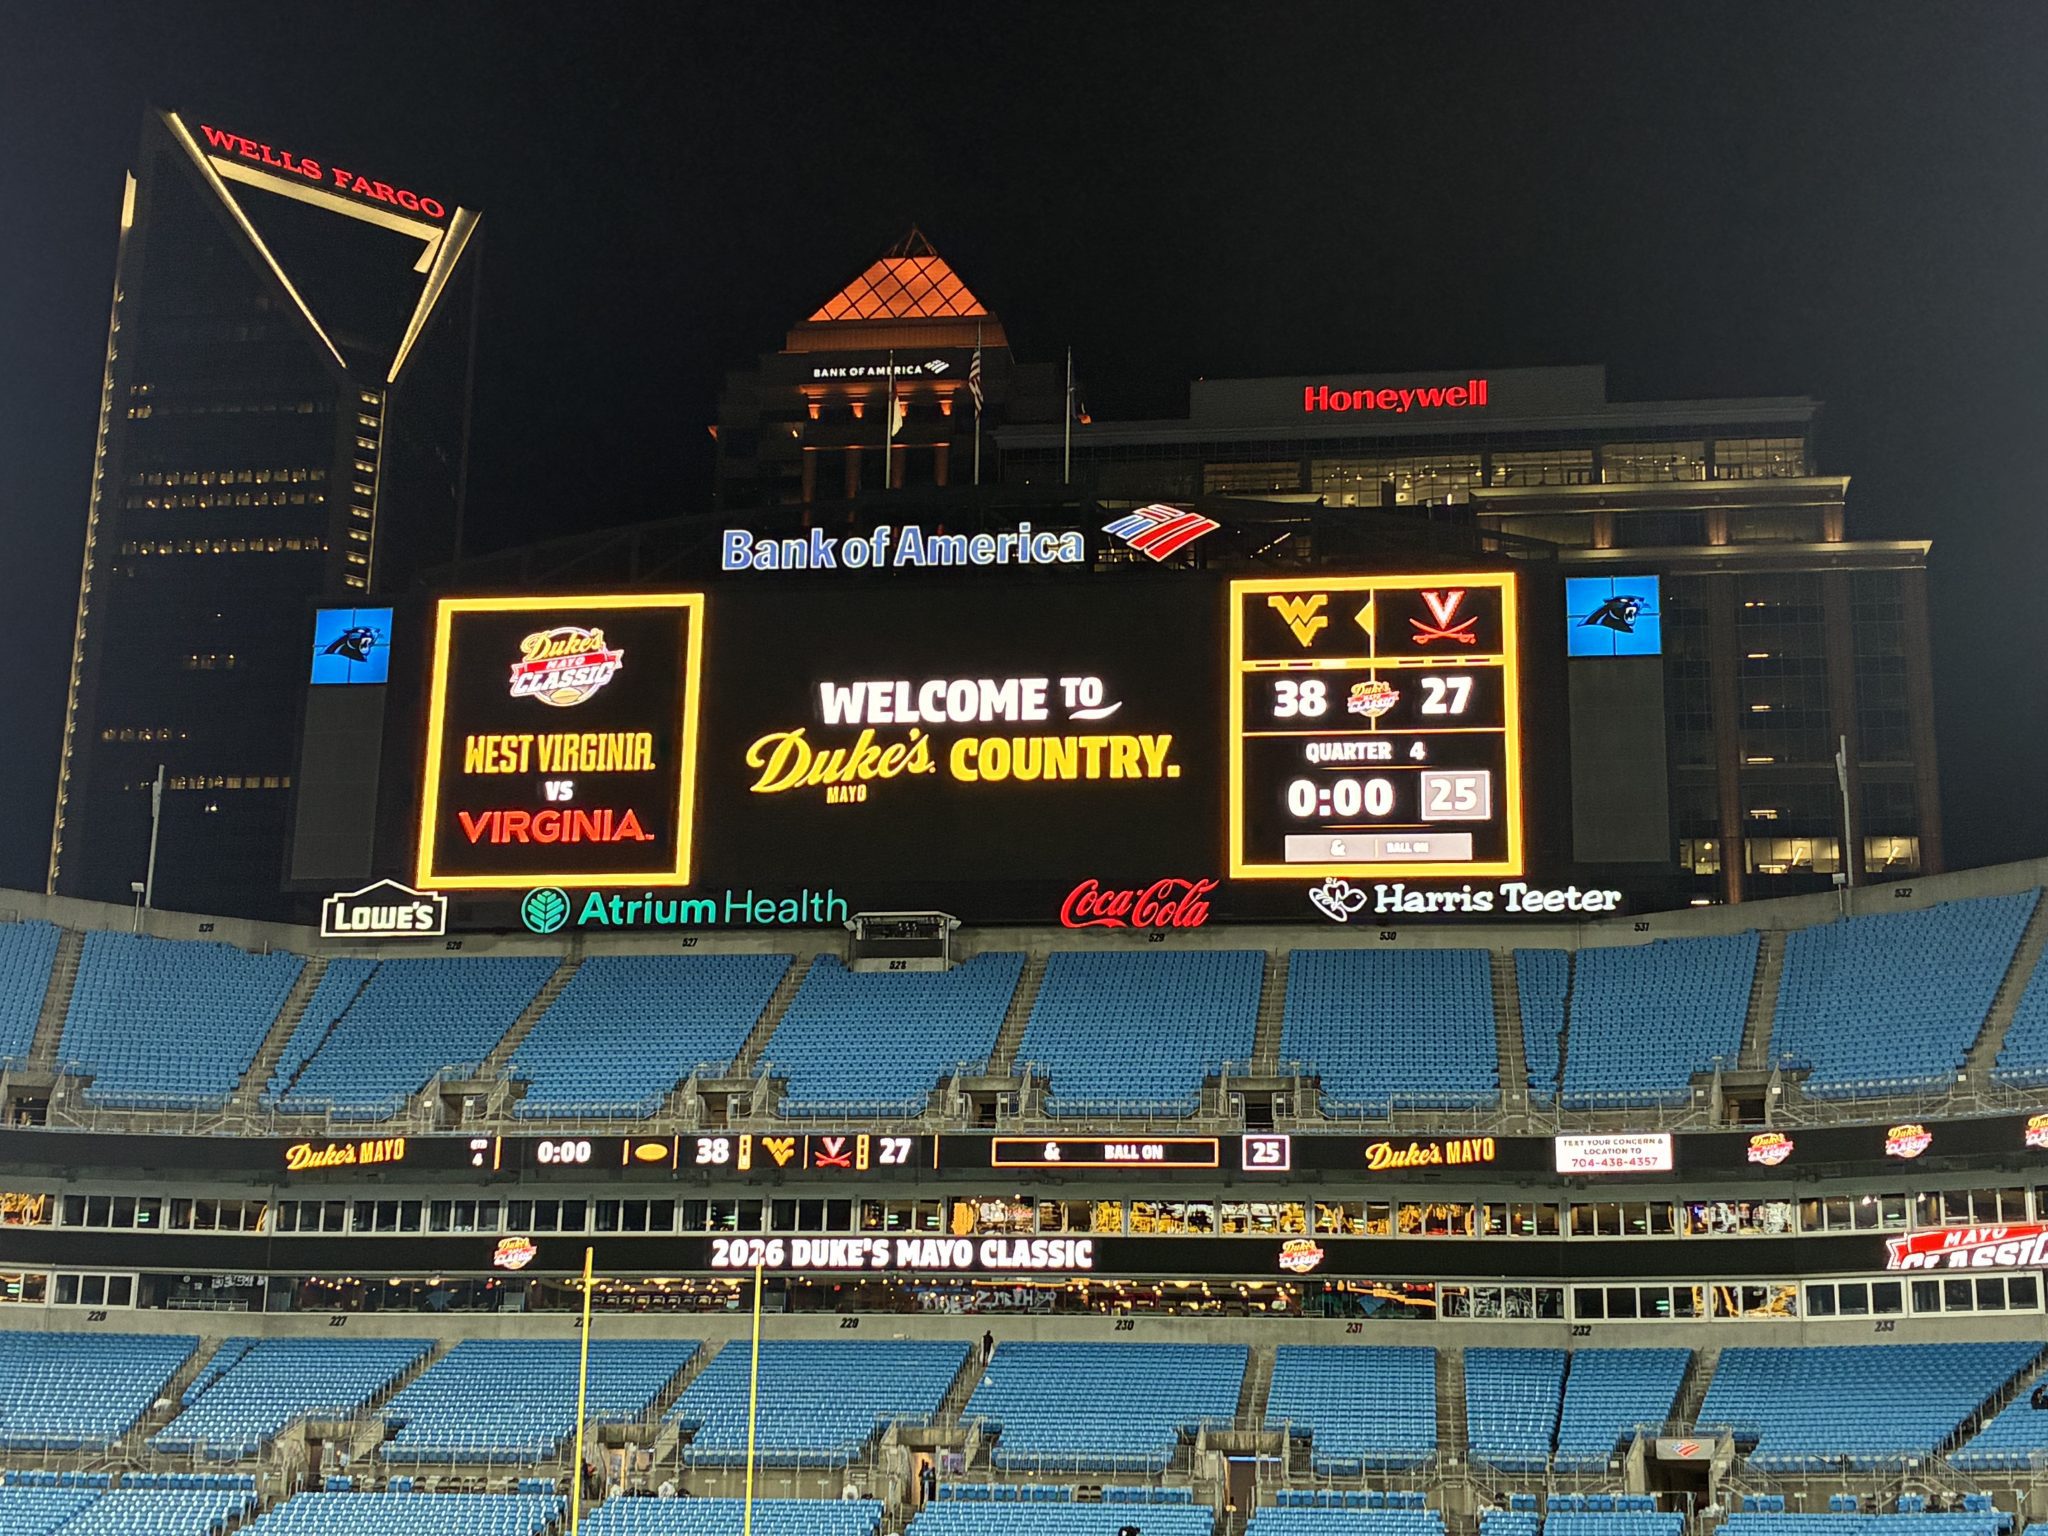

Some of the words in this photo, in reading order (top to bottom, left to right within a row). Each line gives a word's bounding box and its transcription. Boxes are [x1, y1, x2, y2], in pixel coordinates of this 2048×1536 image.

[200, 124, 323, 180] WELLS
[332, 168, 446, 218] FARGO
[813, 368, 847, 378] BANK
[848, 367, 866, 377] OF
[866, 364, 923, 376] AMERICA
[1304, 379, 1488, 414] Honeywell
[721, 527, 838, 571] Bank
[841, 525, 890, 569] of
[892, 521, 1086, 567] America
[513, 660, 618, 695] CLASSIC
[545, 656, 587, 671] MAYO
[820, 678, 1048, 724] WELCOME
[1060, 677, 1104, 708] TO
[1273, 680, 1327, 718] 38
[1420, 676, 1473, 714] 27
[463, 733, 535, 774] WEST
[746, 727, 936, 793] Duke's
[949, 734, 1181, 782] COUNTRY.
[1305, 741, 1393, 764] QUARTER
[1409, 741, 1426, 761] 4
[826, 784, 868, 804] MAYO
[1287, 778, 1395, 817] 0:00
[1429, 777, 1478, 812] 25
[458, 808, 655, 845] VIRGINIA
[1330, 839, 1346, 856] &
[577, 892, 717, 925] Atrium
[724, 888, 848, 924] Health
[1060, 878, 1220, 930] Coca-Cola
[1373, 883, 1494, 914] Harris
[1499, 882, 1622, 913] Teeter
[334, 901, 434, 932] LOWE'S
[682, 938, 699, 947] 527
[285, 1142, 356, 1170] Duke's
[358, 1137, 405, 1164] MAYO
[537, 1140, 592, 1164] 0:00
[695, 1137, 730, 1164] 38
[879, 1137, 912, 1164] 27
[1043, 1142, 1062, 1161] &
[1104, 1144, 1140, 1160] BALL
[1141, 1144, 1163, 1160] ON
[1252, 1141, 1281, 1164] 25
[1365, 1141, 1443, 1170] Duke's
[1445, 1137, 1496, 1164] MAYO
[711, 1239, 785, 1267] 2026
[791, 1238, 889, 1267] DUKE'S
[896, 1239, 973, 1267] MAYO
[980, 1240, 1093, 1268] CLASSIC
[328, 1316, 347, 1326] 227
[1115, 1320, 1134, 1331] 230
[1345, 1323, 1363, 1334] 231
[1572, 1326, 1591, 1337] 232
